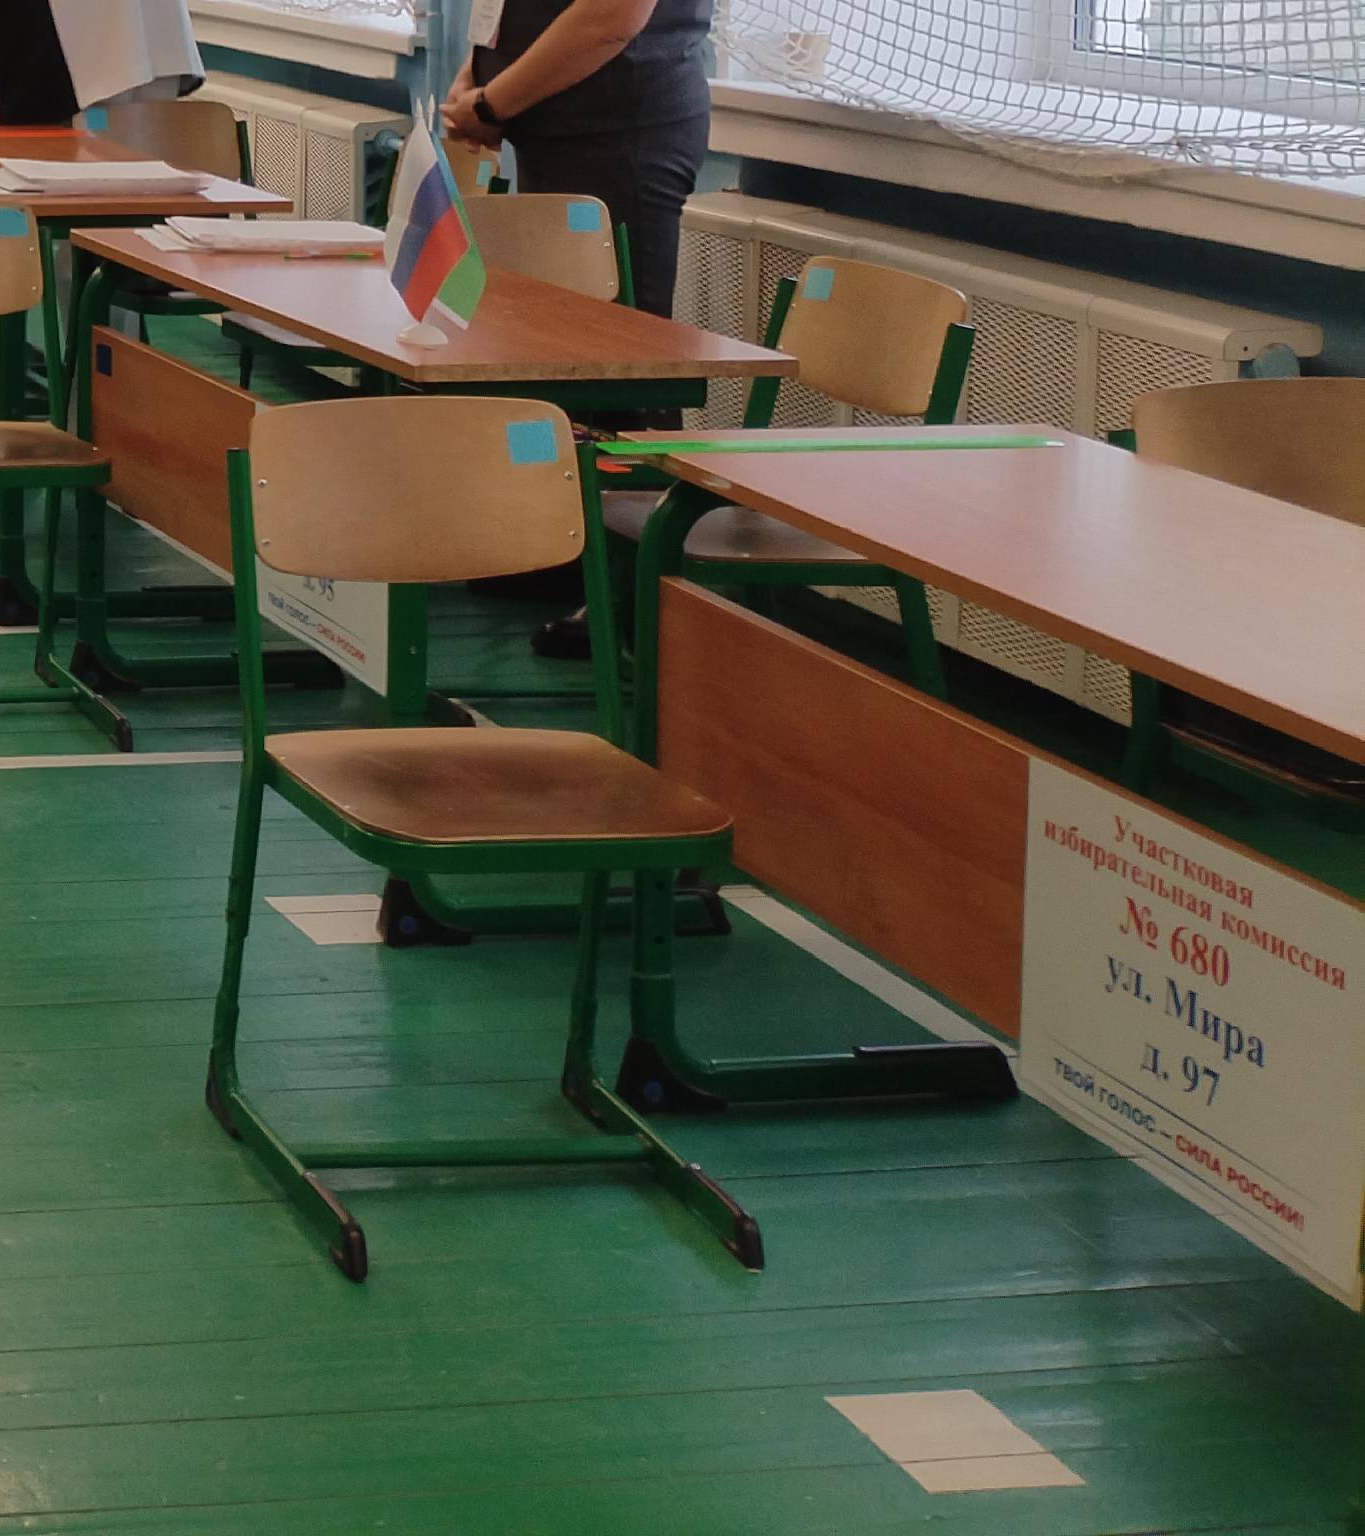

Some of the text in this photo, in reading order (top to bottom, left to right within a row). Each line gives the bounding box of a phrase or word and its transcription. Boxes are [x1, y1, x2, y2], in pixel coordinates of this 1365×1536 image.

[1043, 819, 1346, 991] избирательная комиссия
[1114, 814, 1254, 909] Участковая
[1118, 895, 1230, 987] № 680
[1104, 954, 1265, 1069] ул. Мира
[1053, 1057, 1095, 1098] ТВОЙ
[1099, 1086, 1156, 1134] ГОЛОС
[1174, 1134, 1223, 1177] СИЛА
[1140, 1042, 1220, 1107] д. 97
